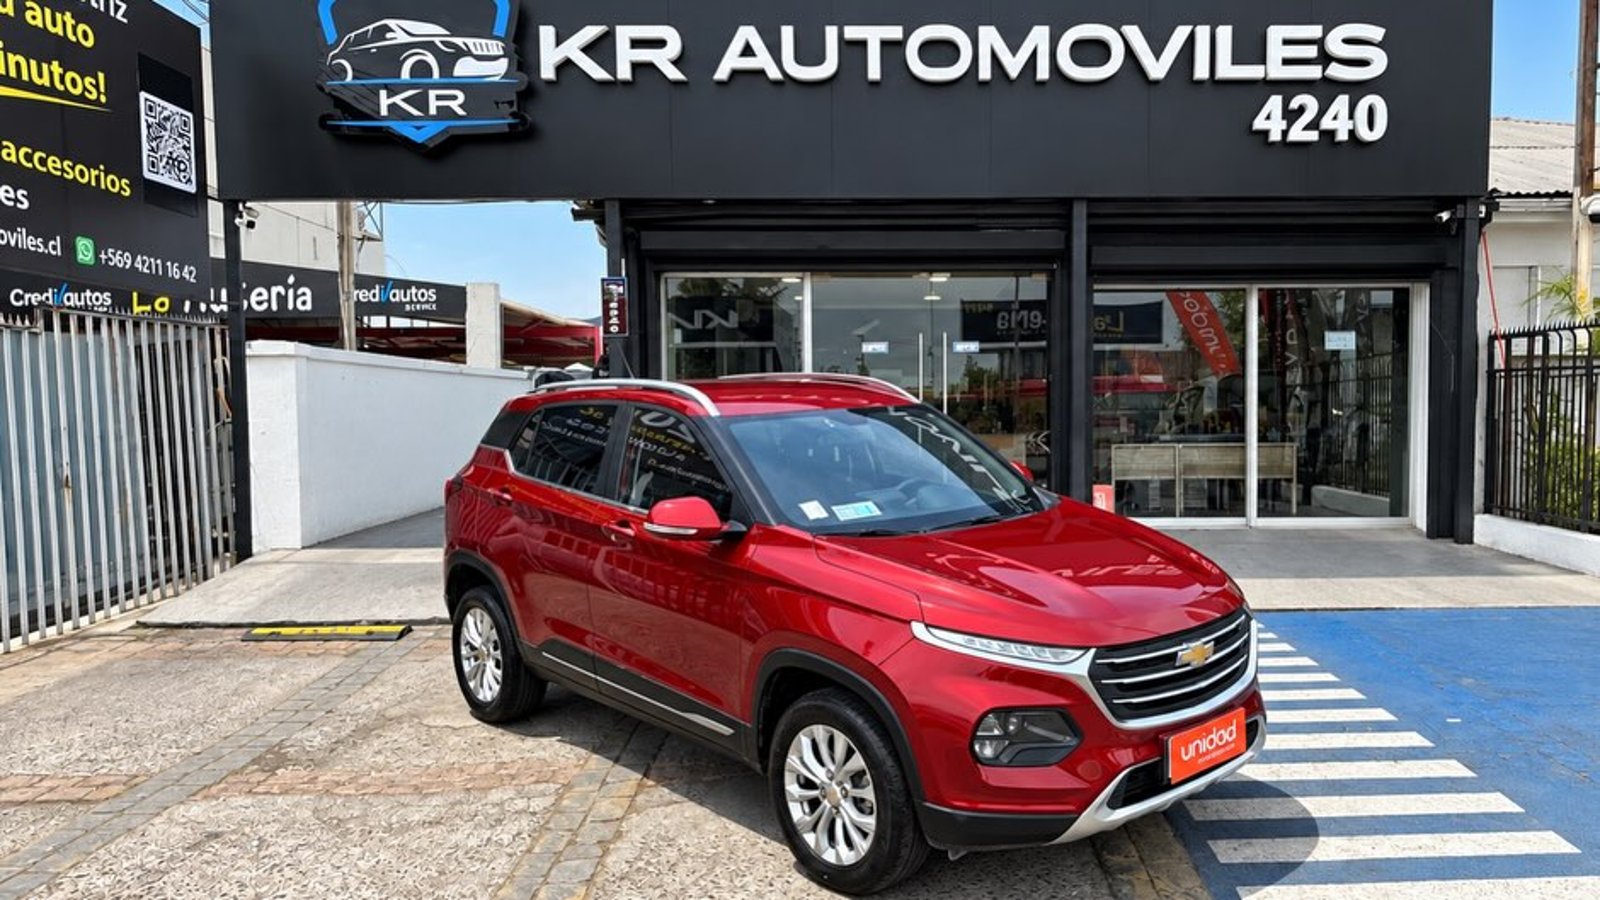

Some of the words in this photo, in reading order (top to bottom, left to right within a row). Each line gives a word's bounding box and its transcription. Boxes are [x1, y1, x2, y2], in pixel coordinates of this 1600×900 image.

[25, 1, 95, 48] auto
[538, 24, 688, 83] KR
[712, 23, 1388, 83] AUTOMOVILES
[379, 89, 467, 117] KR
[1251, 94, 1388, 142] 4240
[1, 140, 131, 197] accesorios
[98, 248, 132, 269] +569
[134, 254, 163, 276] 4211
[1181, 718, 1237, 761] unidad
